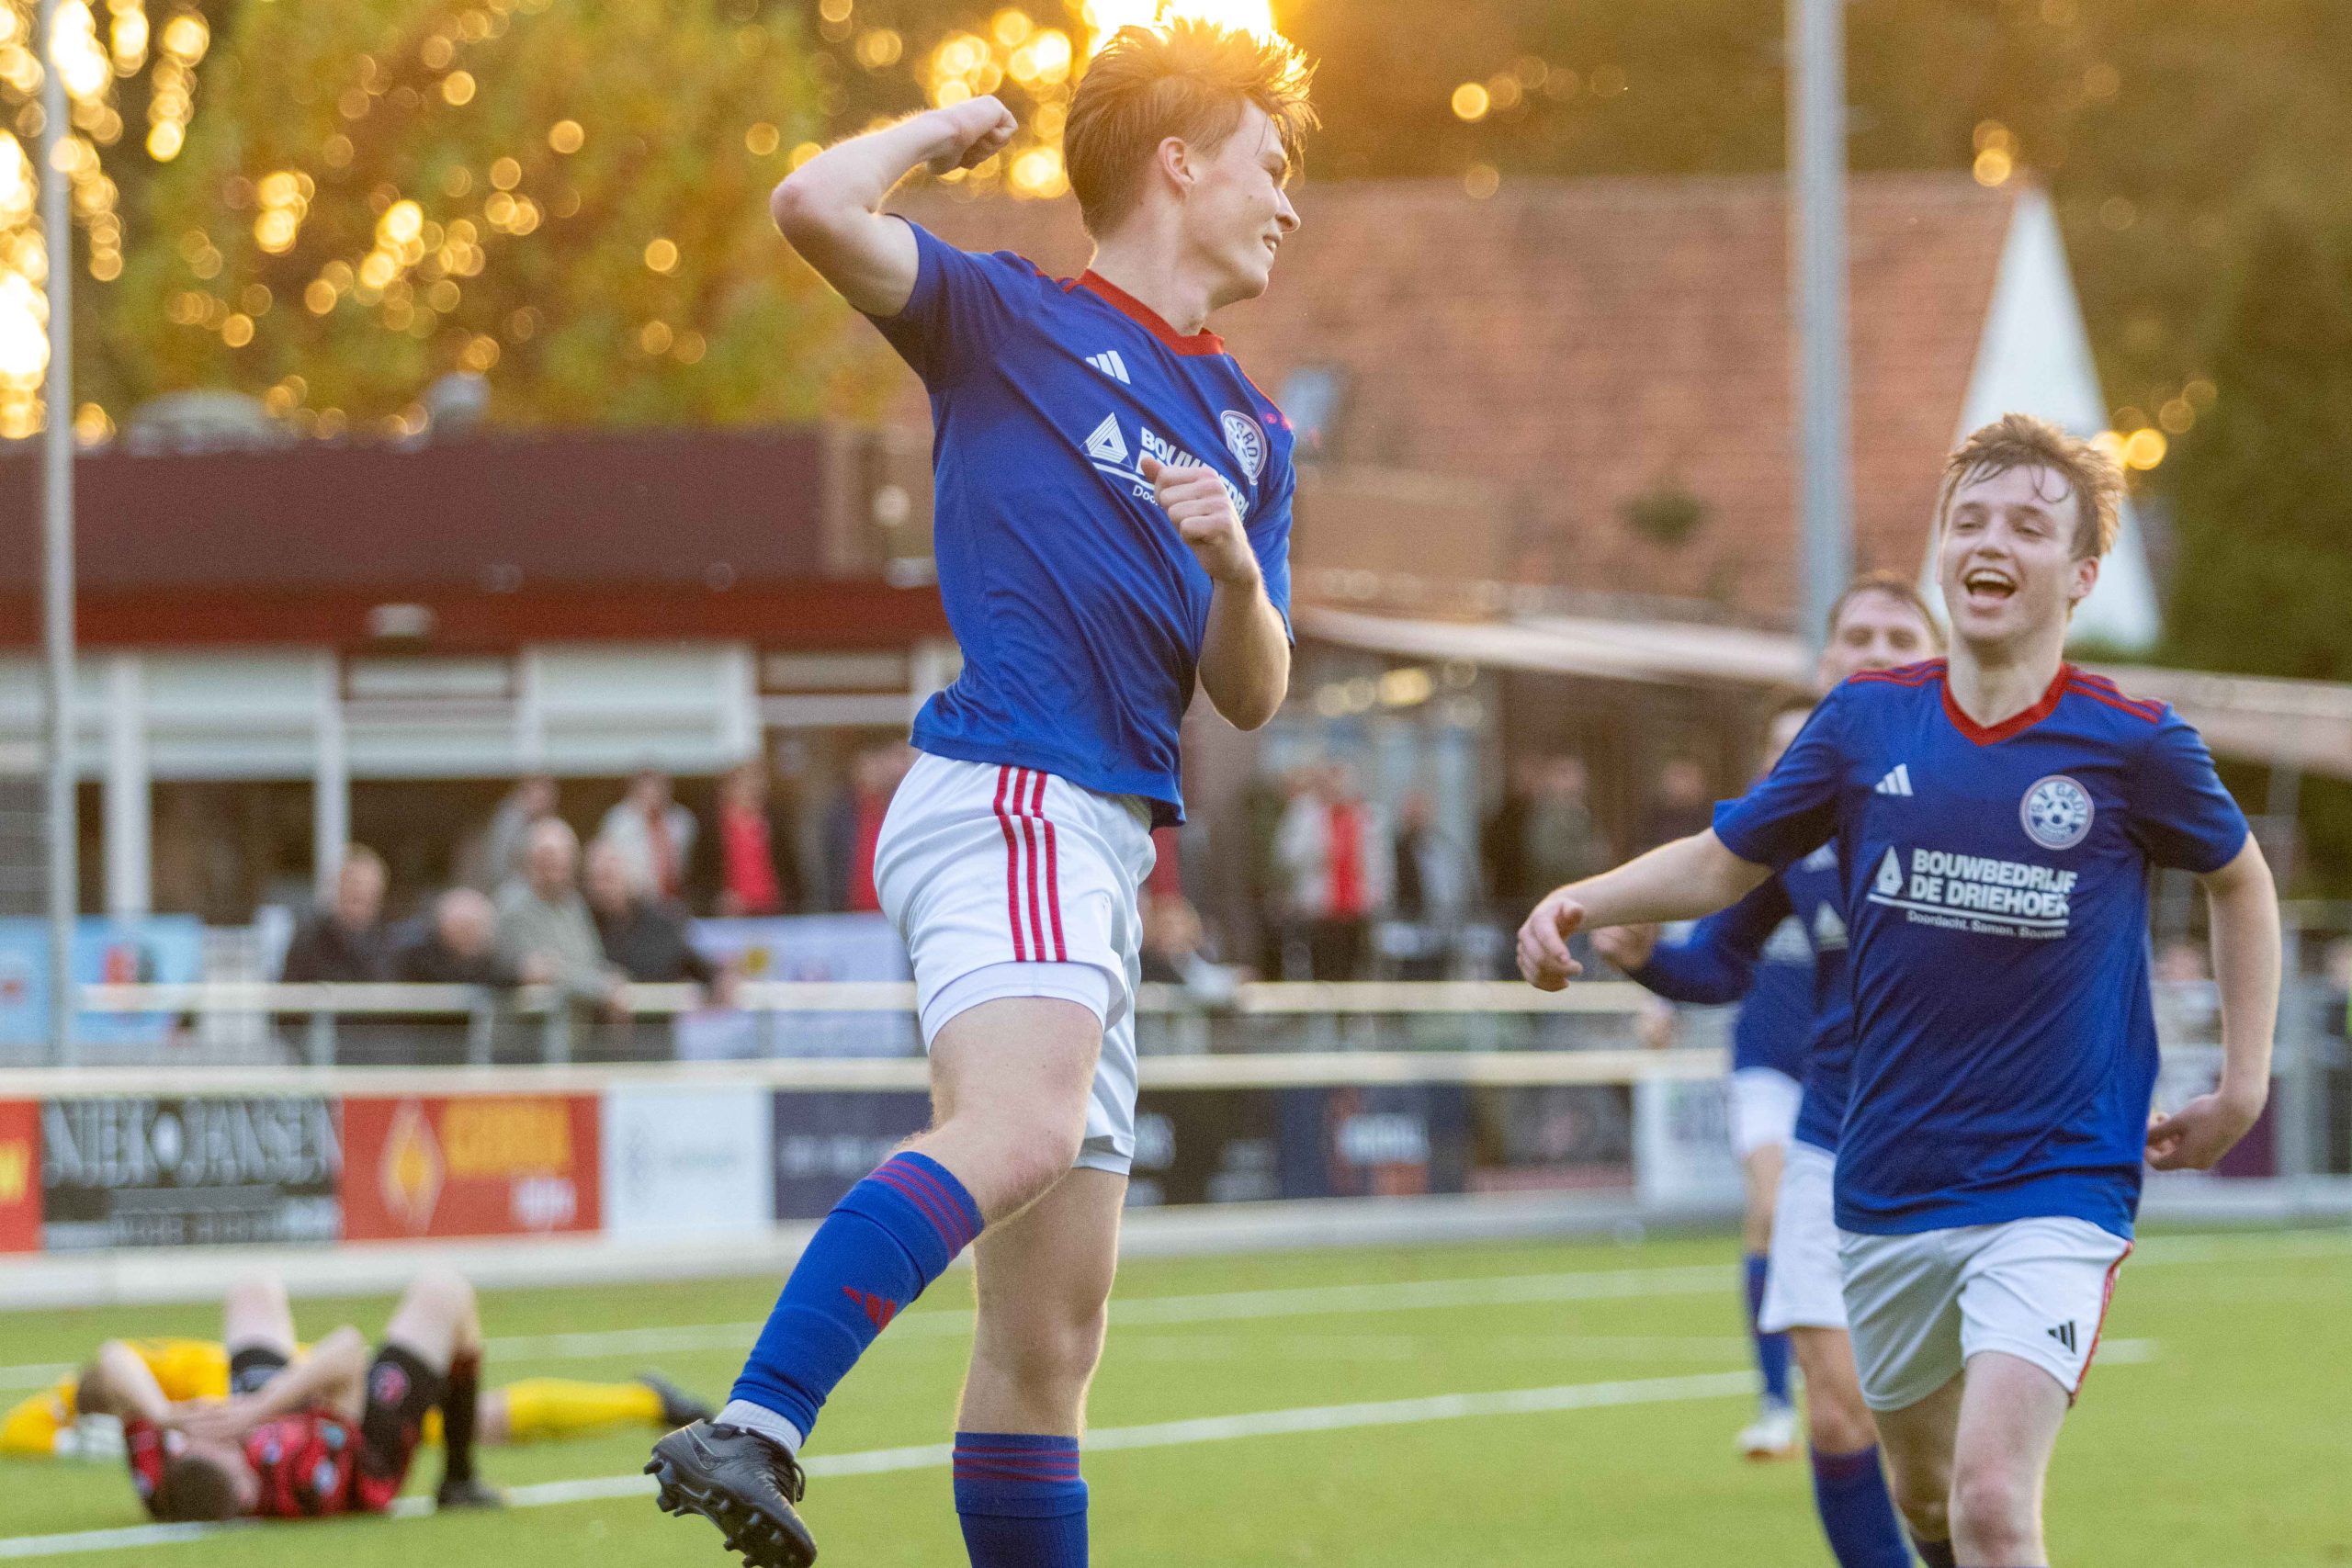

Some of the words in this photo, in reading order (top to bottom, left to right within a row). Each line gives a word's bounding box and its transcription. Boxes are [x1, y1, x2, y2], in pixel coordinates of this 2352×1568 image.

[1913, 849, 2077, 893] BOUWBEDRIJF
[1910, 874, 1942, 901] DE
[1947, 881, 2069, 917] DRIEHOEK
